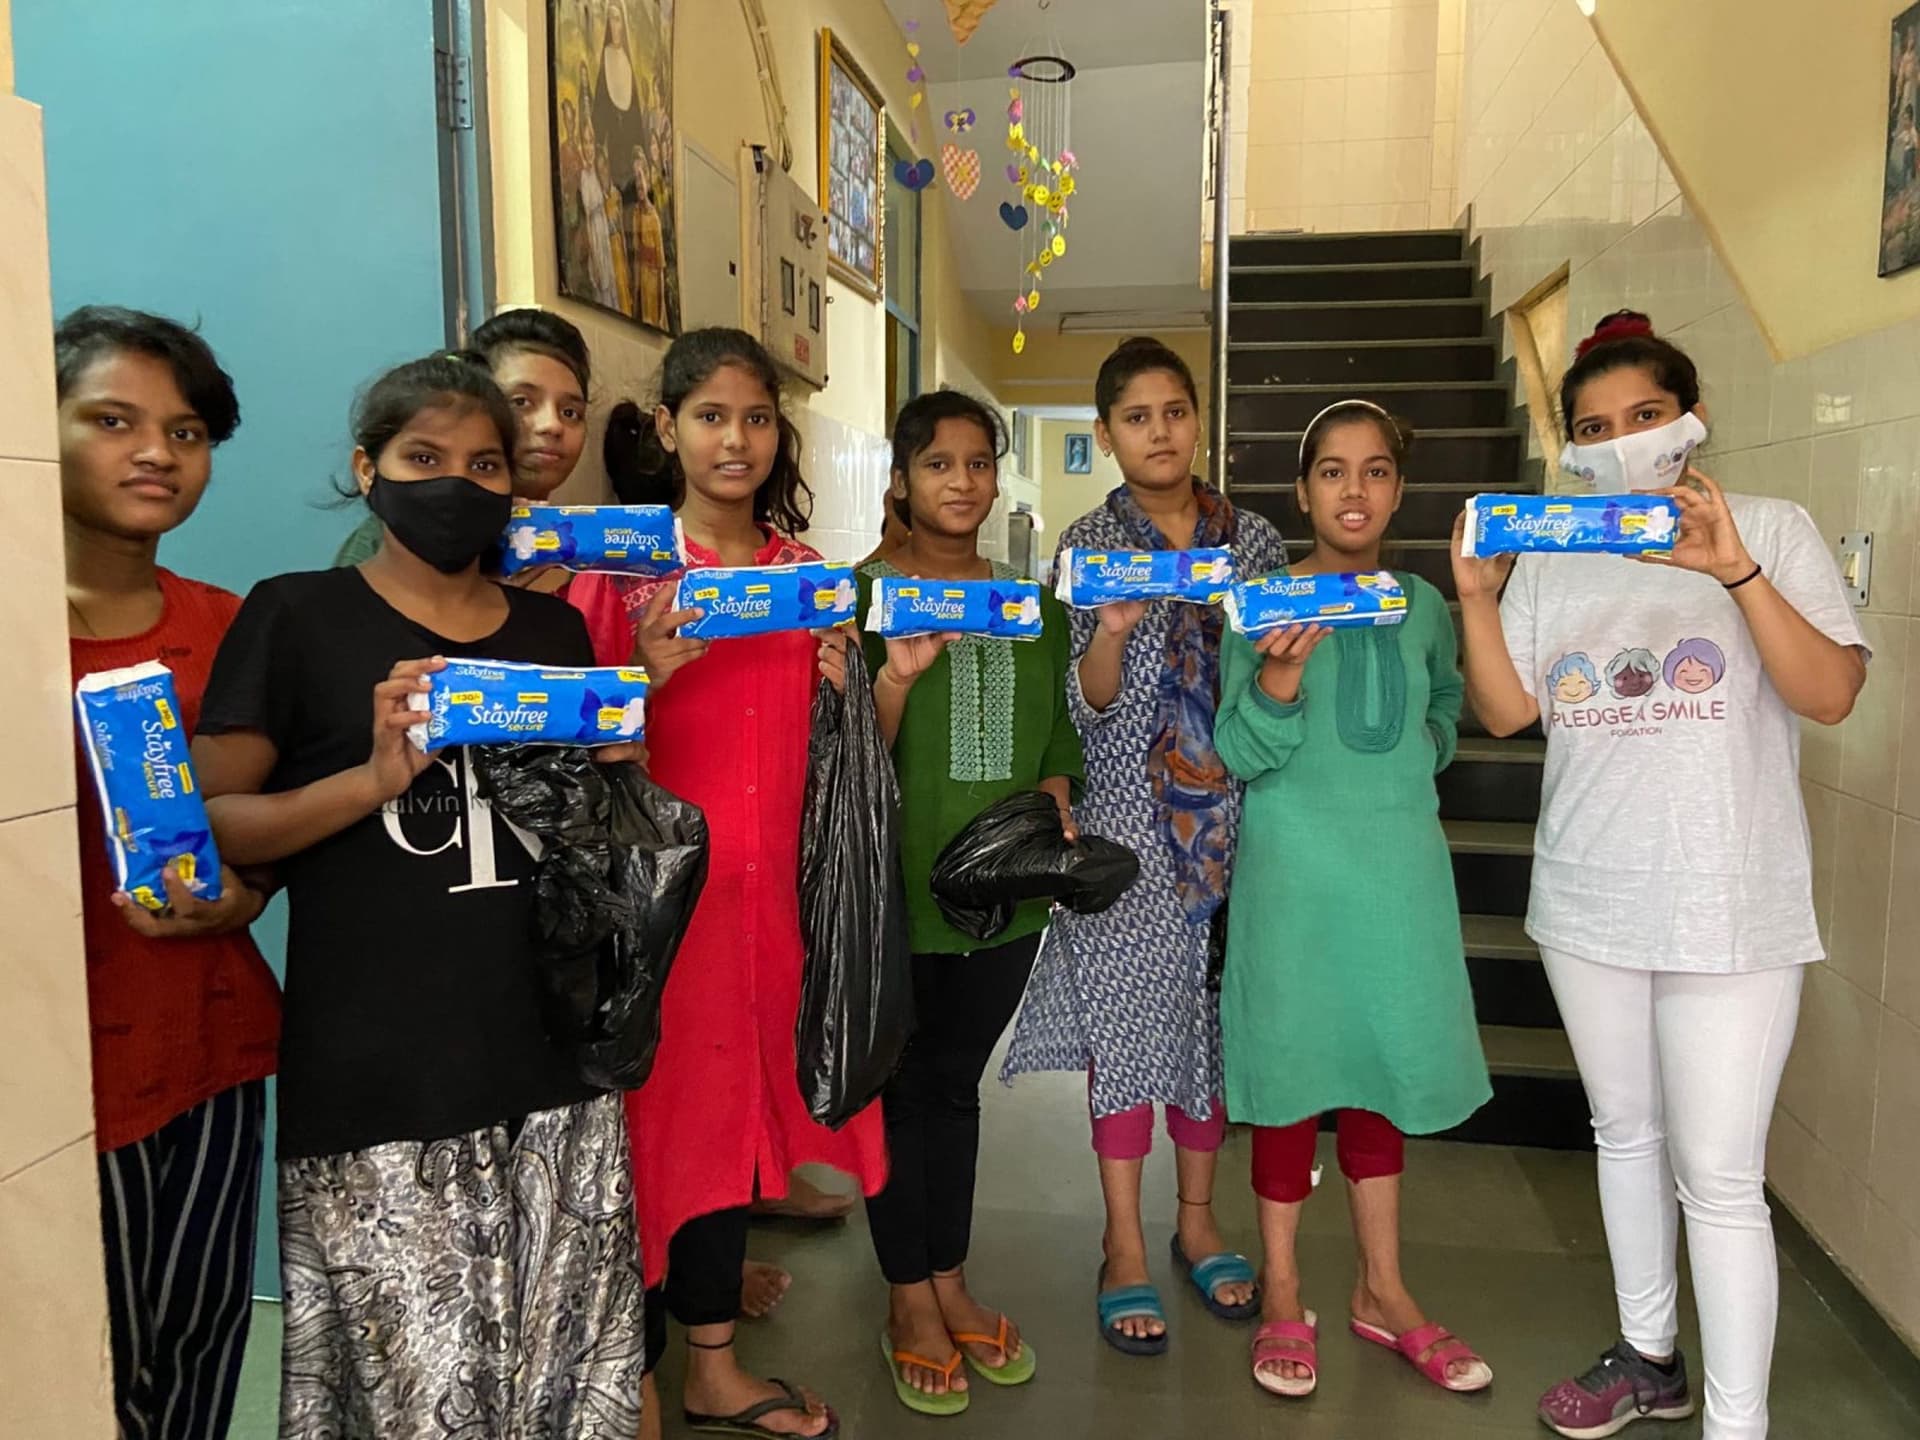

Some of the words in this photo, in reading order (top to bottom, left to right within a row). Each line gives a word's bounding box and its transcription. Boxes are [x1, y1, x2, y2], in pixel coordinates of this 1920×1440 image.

[1503, 513, 1573, 533] Stayfree
[604, 533, 661, 551] Stayfree
[1096, 562, 1153, 580] Stayfree
[1260, 579, 1316, 597] Stayfree
[711, 595, 772, 618] Stayfree
[739, 610, 770, 619] secure
[910, 596, 965, 615] Stayfree
[936, 611, 965, 620] secure
[455, 665, 505, 678] Stayfree
[467, 702, 549, 729] Stayfree
[1551, 704, 1633, 728] PLEDGE
[1652, 700, 1727, 720] SMILE
[507, 723, 545, 732] secure
[142, 719, 177, 799] Stayfree
[142, 761, 160, 799] secure
